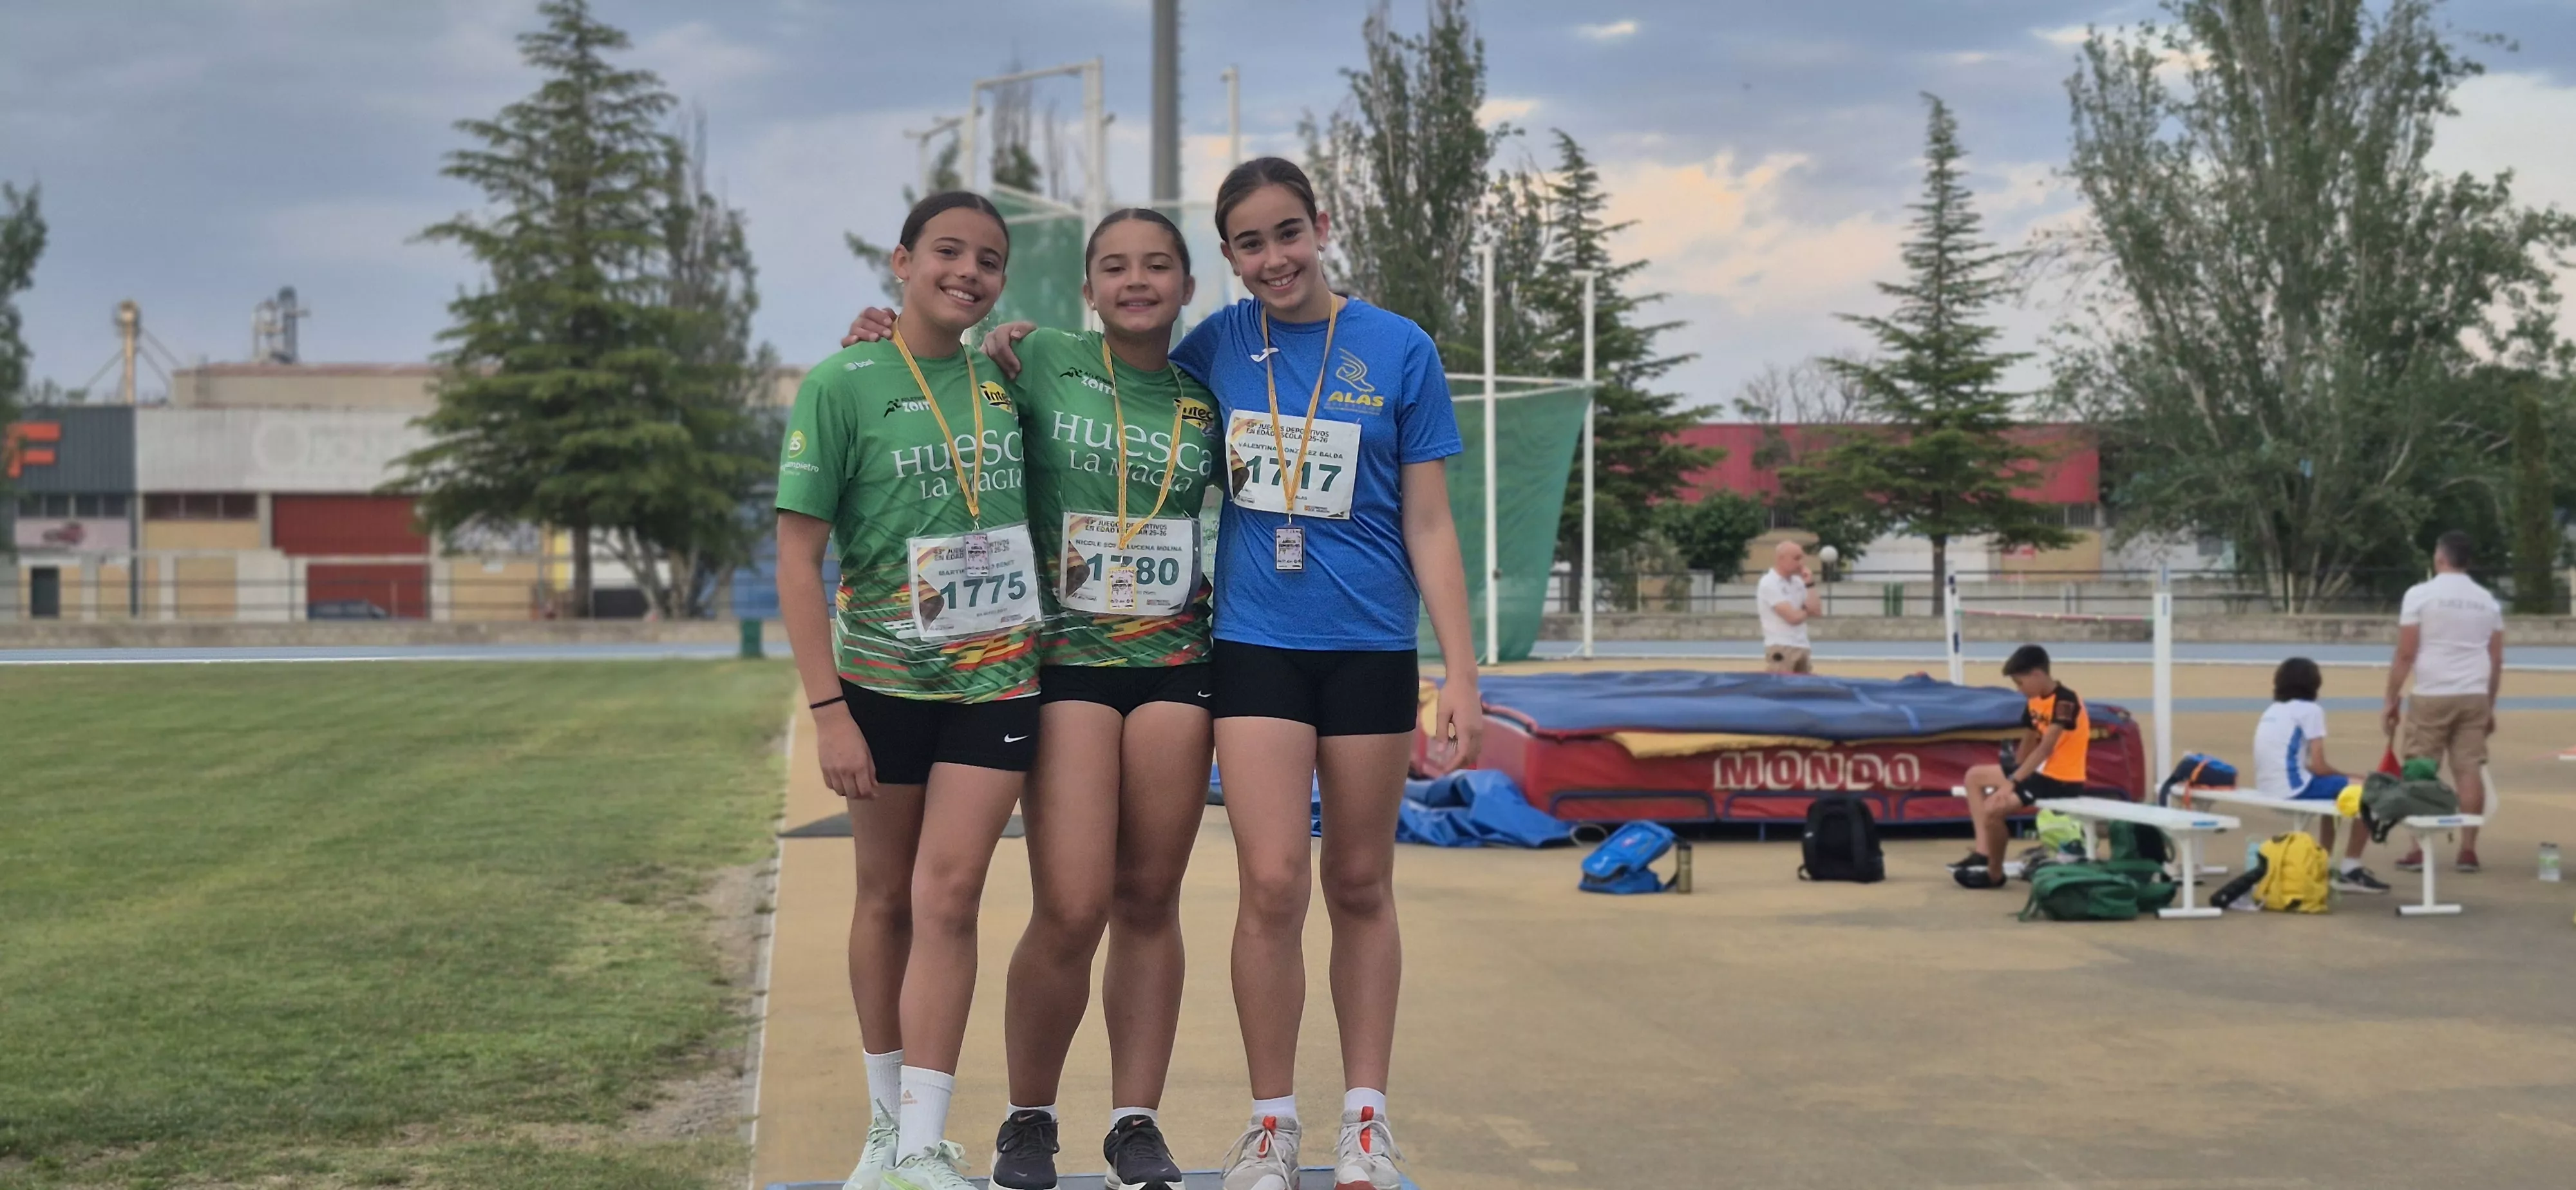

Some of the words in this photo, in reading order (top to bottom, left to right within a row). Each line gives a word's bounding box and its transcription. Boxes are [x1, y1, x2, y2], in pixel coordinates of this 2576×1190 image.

[1328, 391, 1384, 407] ALAS
[1246, 455, 1342, 492] 1717
[1086, 552, 1180, 586] 1780
[940, 570, 1027, 610] 1775
[1714, 750, 1922, 791] MONDO
